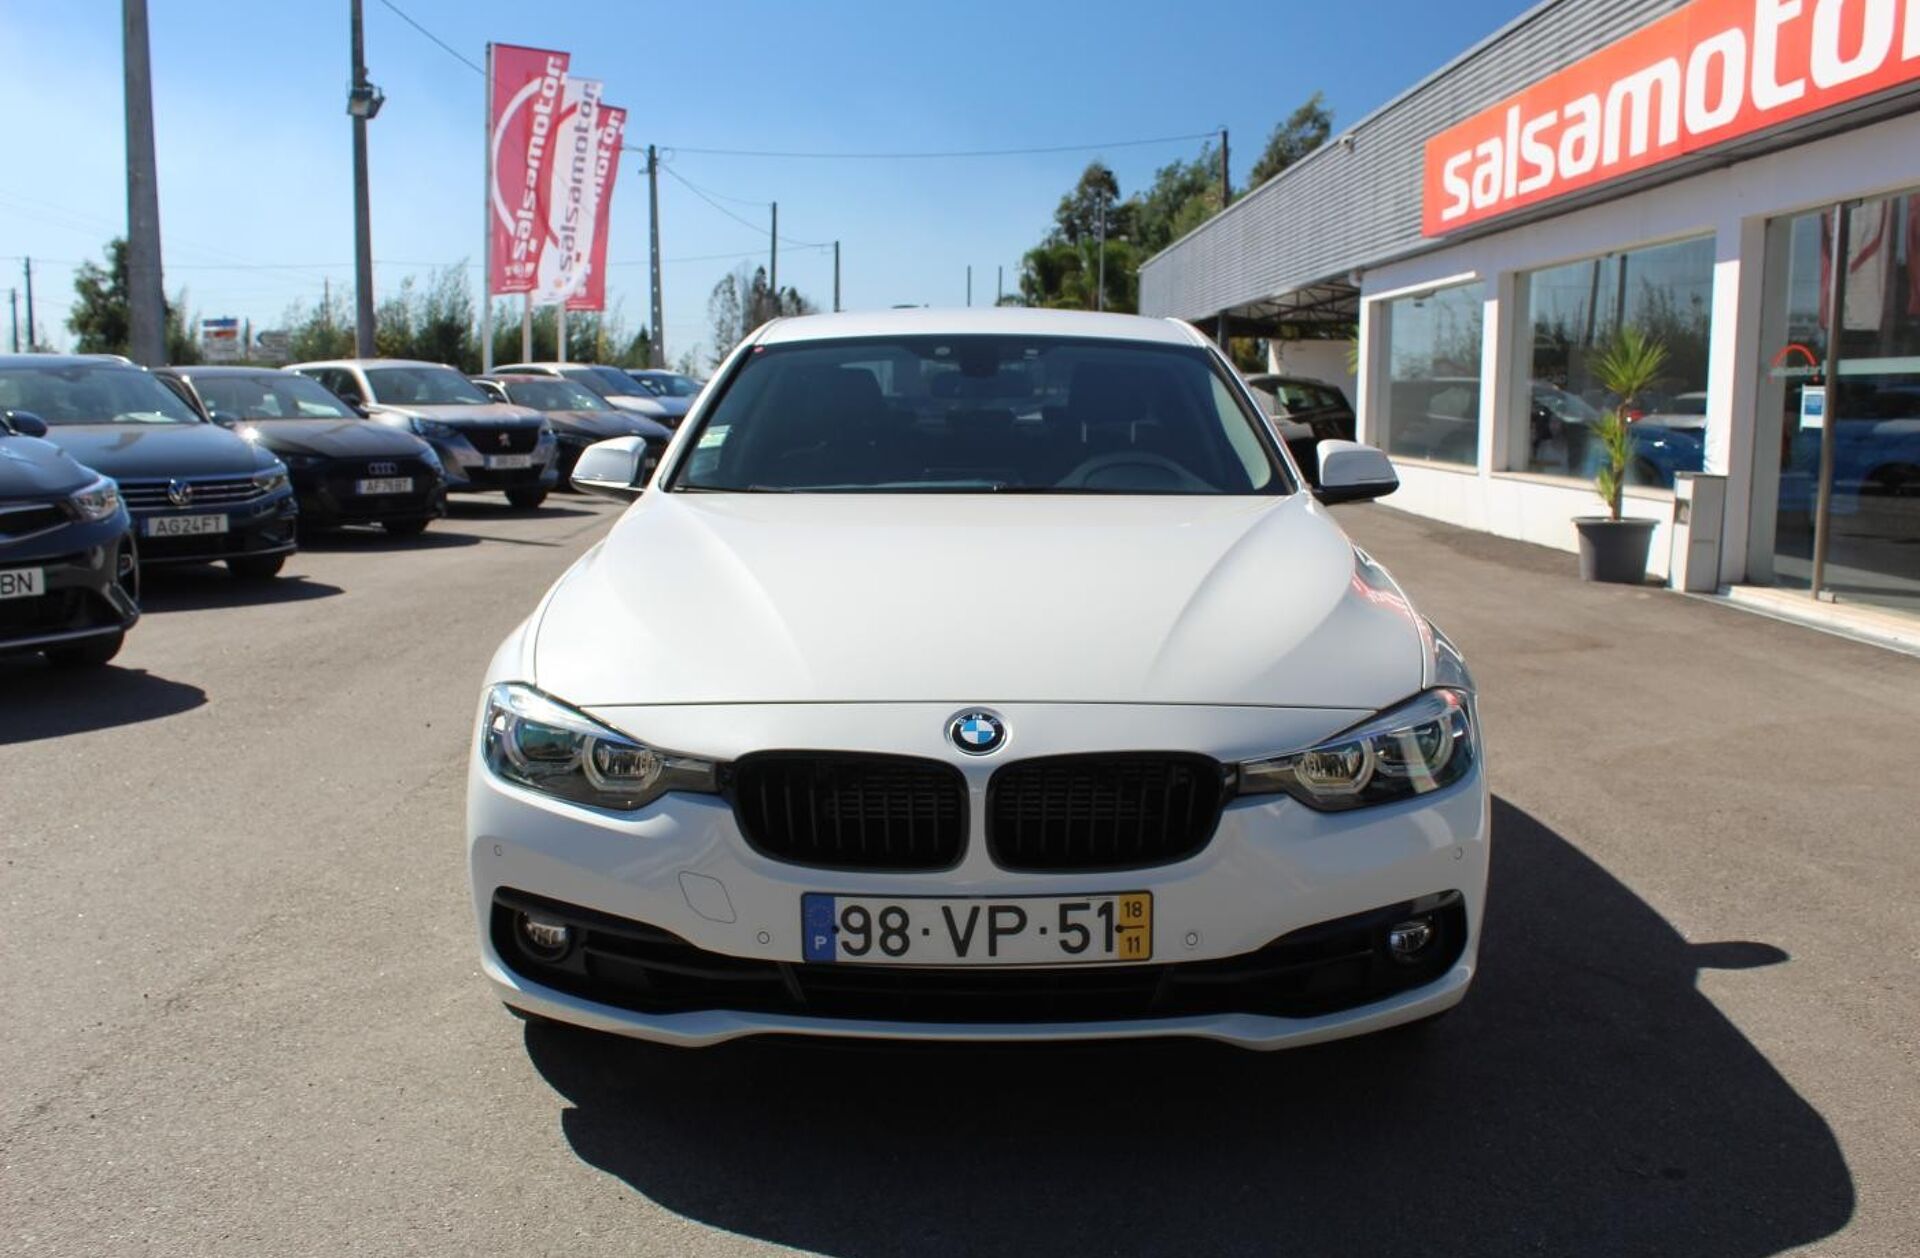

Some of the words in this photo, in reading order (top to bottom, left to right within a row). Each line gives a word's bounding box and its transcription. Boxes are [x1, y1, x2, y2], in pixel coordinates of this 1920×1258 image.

[512, 55, 561, 261] salsamotor
[560, 82, 594, 272] salsamotor
[155, 515, 221, 534] AG24FT
[0, 573, 33, 595] BN
[1124, 901, 1143, 918] 18
[814, 936, 827, 950] P
[1126, 936, 1141, 953] 11
